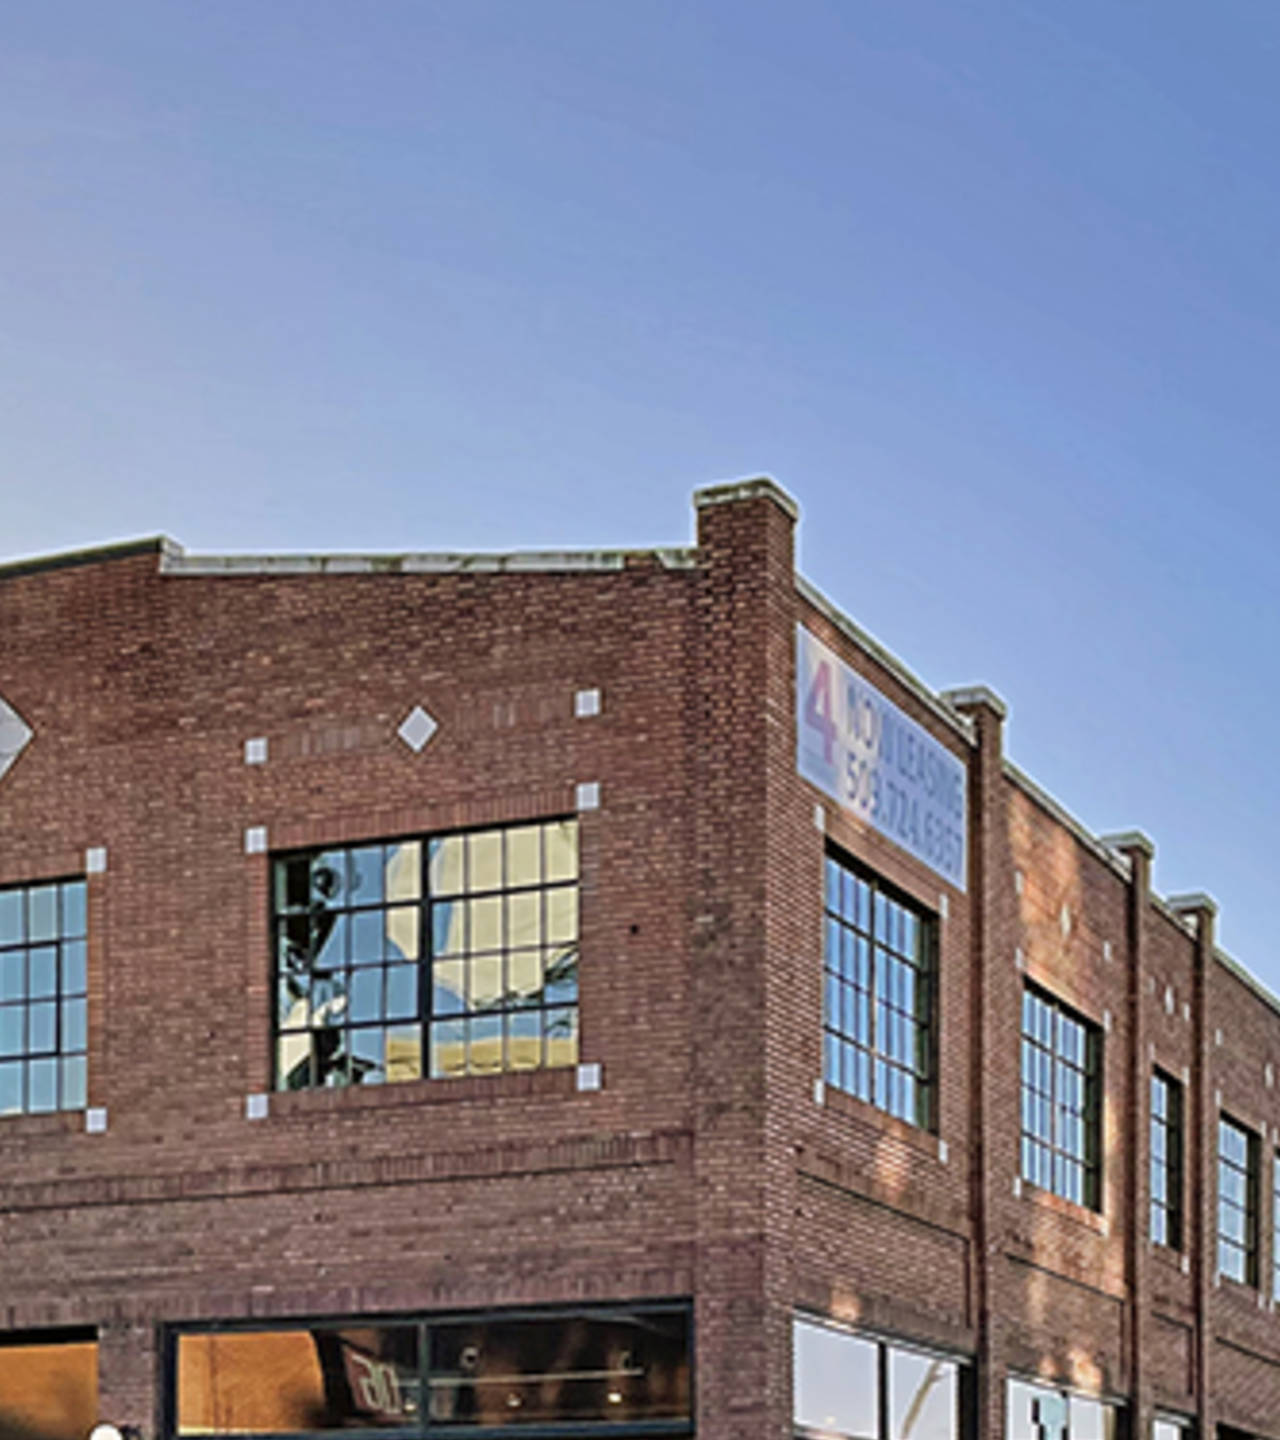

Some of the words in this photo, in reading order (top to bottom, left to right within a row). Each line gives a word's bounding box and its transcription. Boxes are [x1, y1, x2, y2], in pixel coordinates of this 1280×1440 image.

[806, 658, 836, 766] 4
[847, 682, 892, 766] NOW
[897, 724, 961, 821] LEASING
